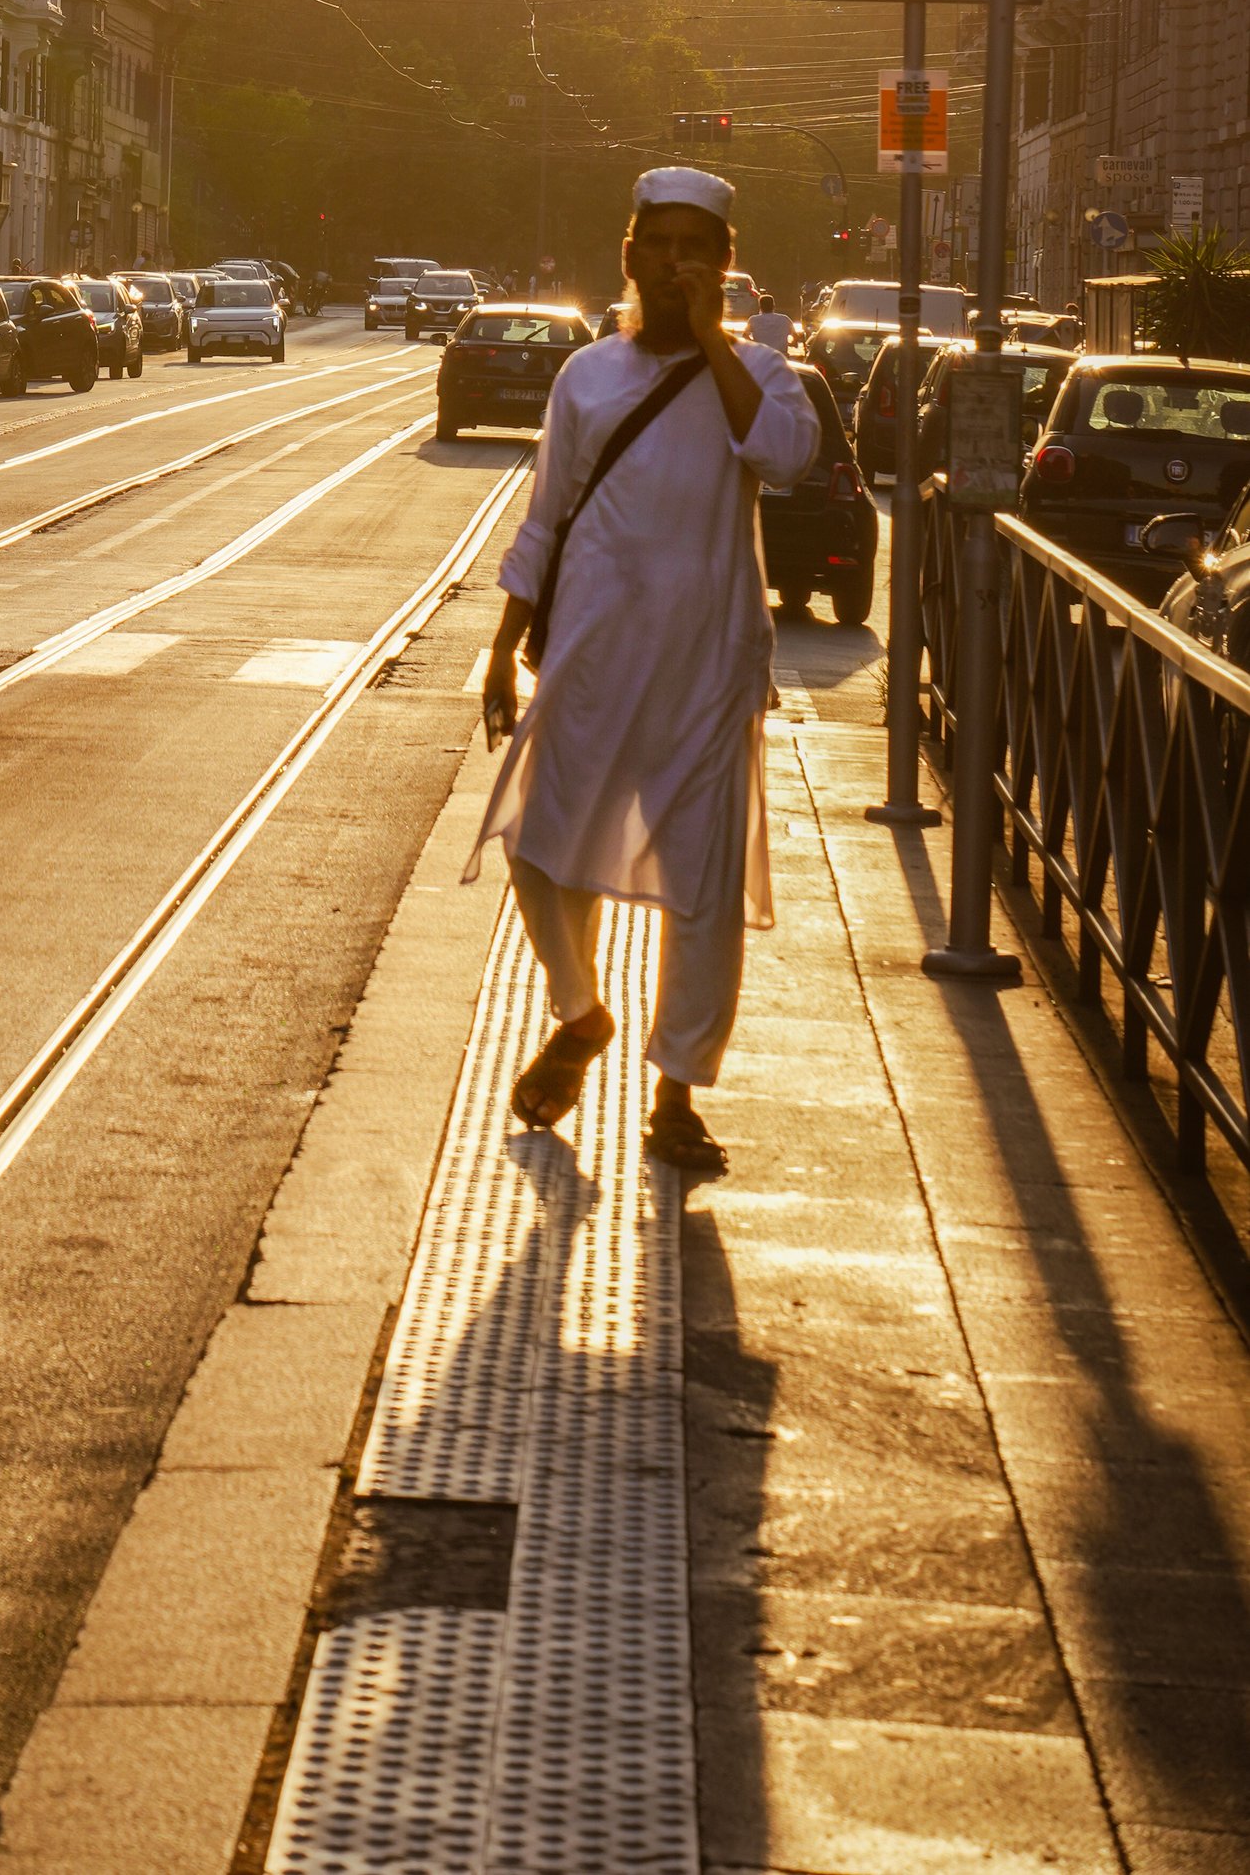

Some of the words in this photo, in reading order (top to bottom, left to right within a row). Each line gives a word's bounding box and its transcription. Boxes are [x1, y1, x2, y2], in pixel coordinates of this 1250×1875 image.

[897, 82, 930, 94] FREE
[1102, 158, 1152, 171] carnevali
[1106, 172, 1149, 184] spose
